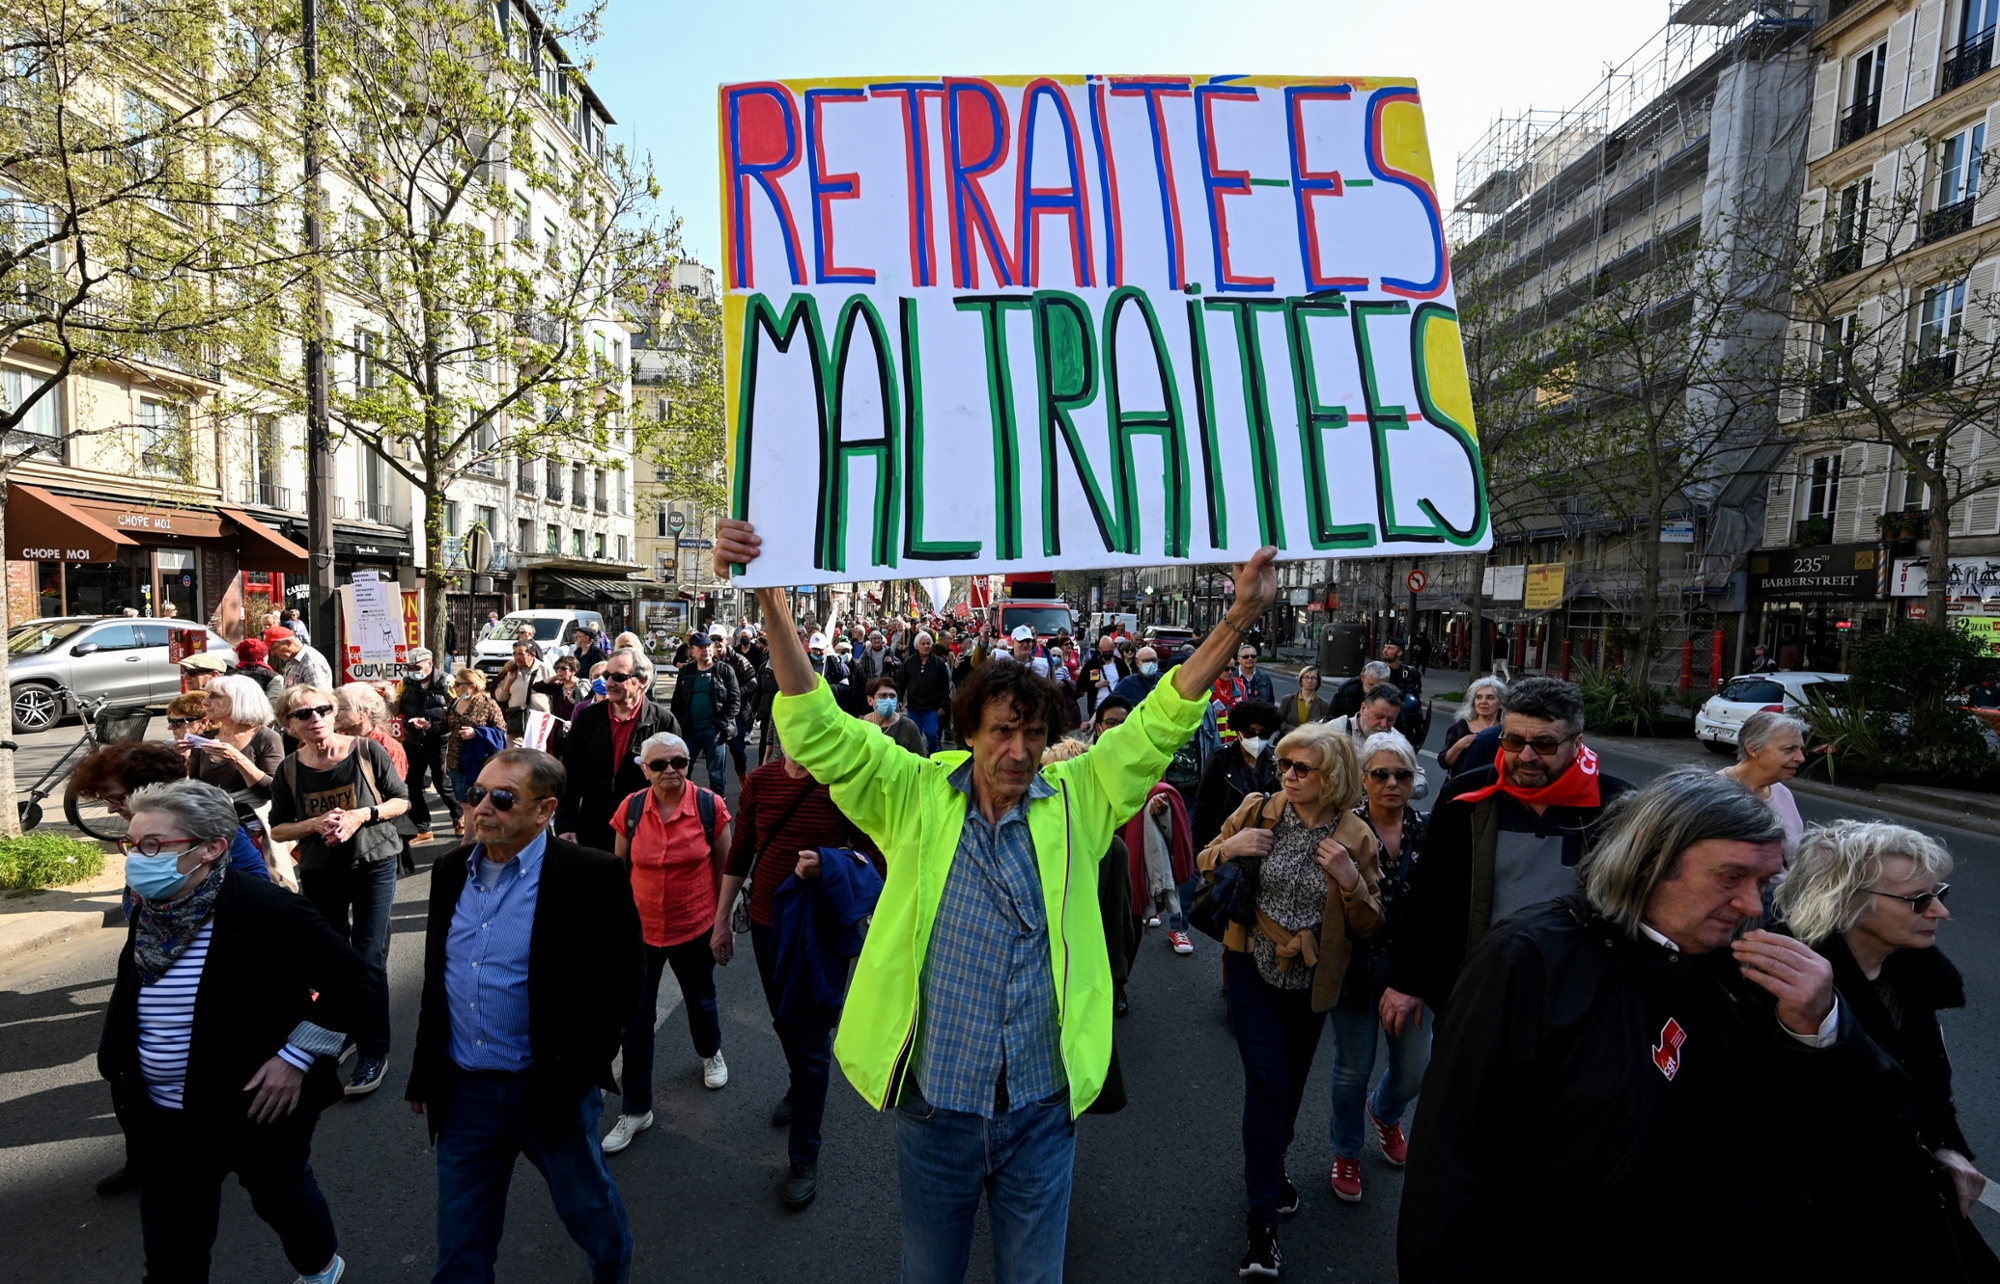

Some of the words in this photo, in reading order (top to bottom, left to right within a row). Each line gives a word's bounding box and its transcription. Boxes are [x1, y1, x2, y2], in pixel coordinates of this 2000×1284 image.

[118, 515, 149, 527] CHOPE
[154, 518, 171, 529] MOI
[22, 548, 61, 559] CHOPE
[66, 550, 90, 560] MOI
[1761, 575, 1858, 588] BARBERSTREET
[310, 790, 352, 813] PARTY
[1664, 1056, 1677, 1076] cgt
